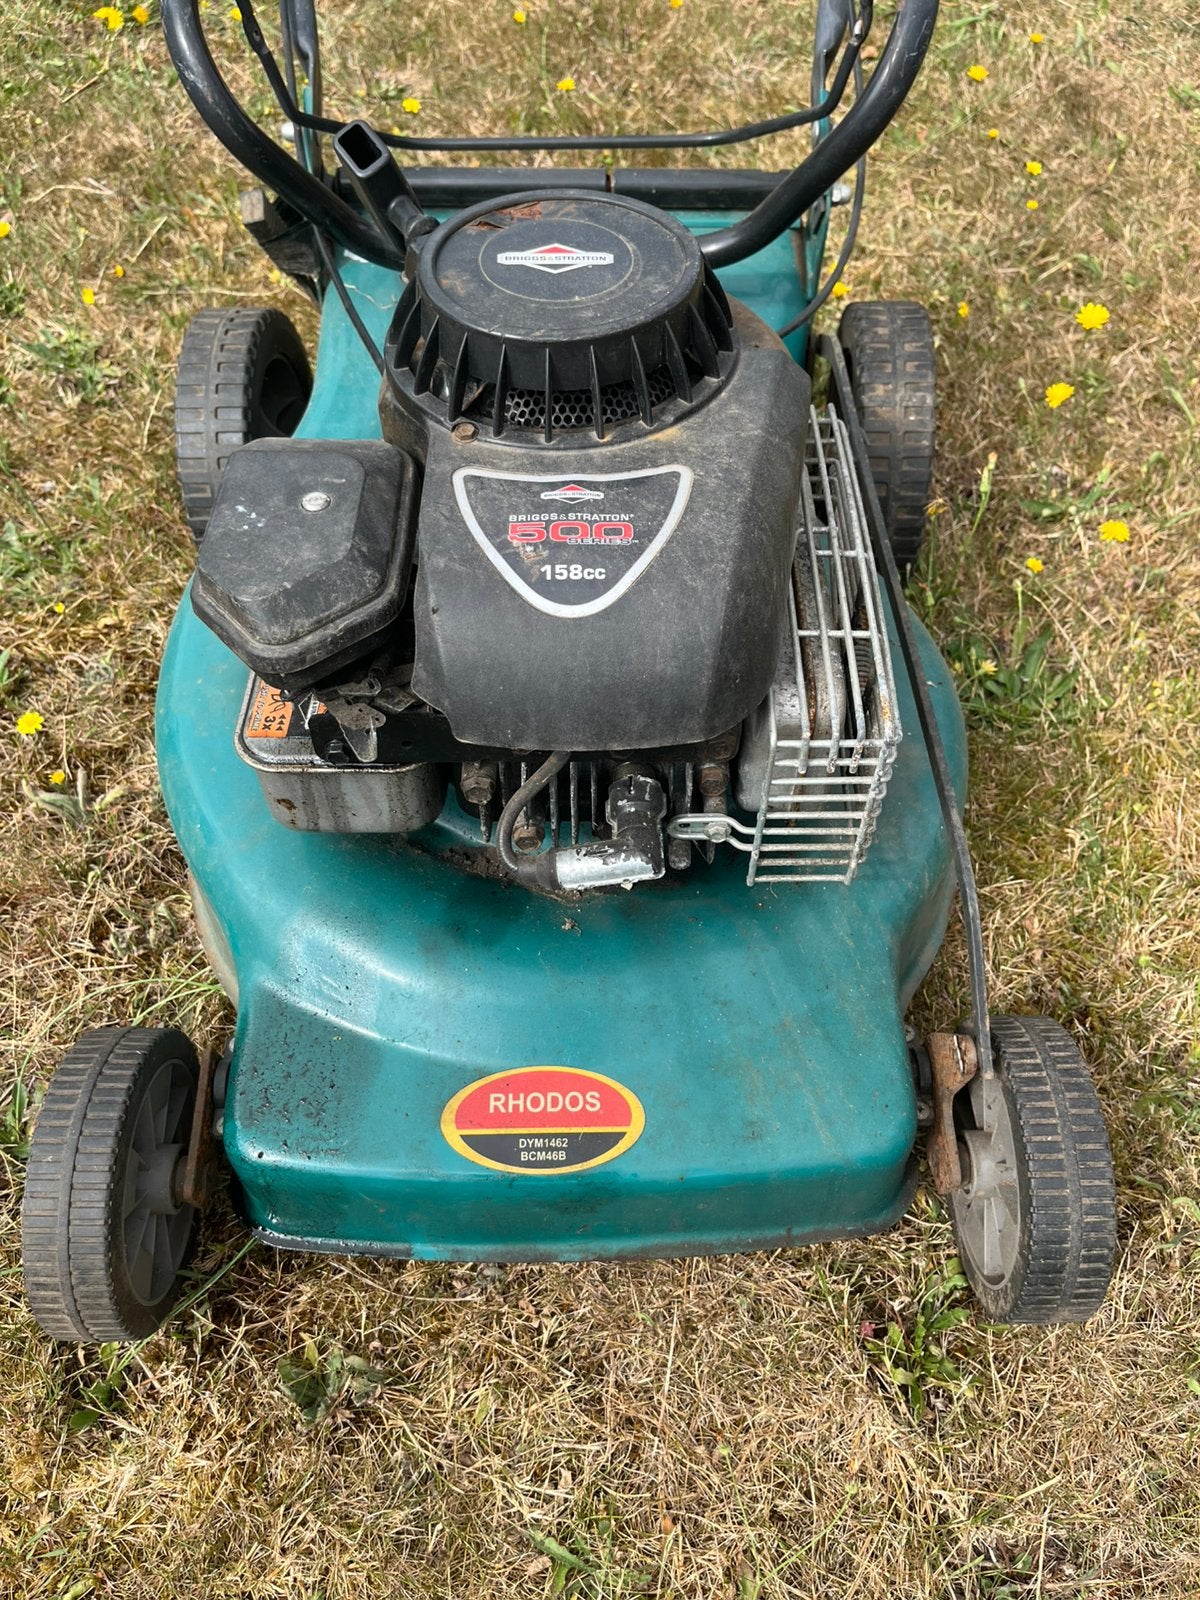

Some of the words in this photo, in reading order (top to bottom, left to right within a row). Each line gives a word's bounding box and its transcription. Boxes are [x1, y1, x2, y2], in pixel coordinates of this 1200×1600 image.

[507, 521, 633, 543] 500
[540, 564, 606, 580] 158cc
[489, 1091, 601, 1113] RHODOS
[519, 1138, 568, 1149] DYM1462
[520, 1151, 566, 1161] BCM46B
